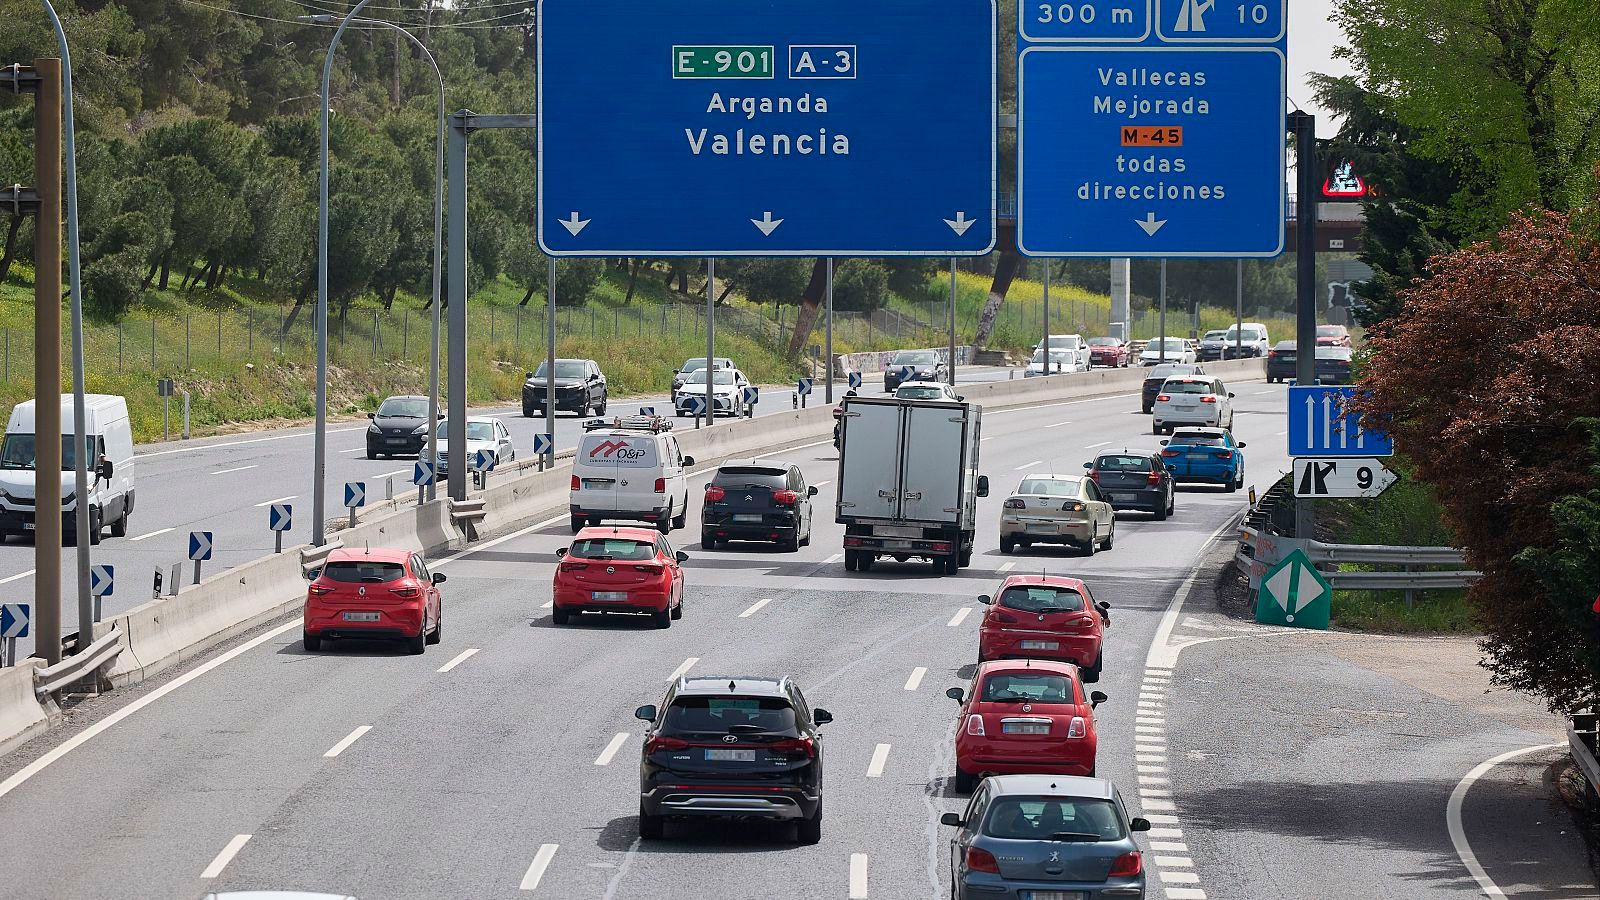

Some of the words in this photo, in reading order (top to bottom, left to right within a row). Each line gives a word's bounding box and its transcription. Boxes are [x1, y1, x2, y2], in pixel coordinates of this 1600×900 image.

[1037, 4, 1096, 24] 300
[1111, 8, 1133, 24] m
[1237, 4, 1268, 24] 10
[678, 50, 769, 73] E-901
[795, 50, 851, 73] A-3
[1097, 68, 1206, 86] Vallecas
[706, 92, 828, 120] Arganda
[1094, 94, 1209, 119] Mejorada
[684, 127, 849, 155] Valencia
[1123, 129, 1180, 144] M-45
[1115, 154, 1186, 173] todas
[1077, 181, 1225, 200] direcciones
[617, 448, 645, 459] O&P
[1356, 466, 1374, 489] 9
